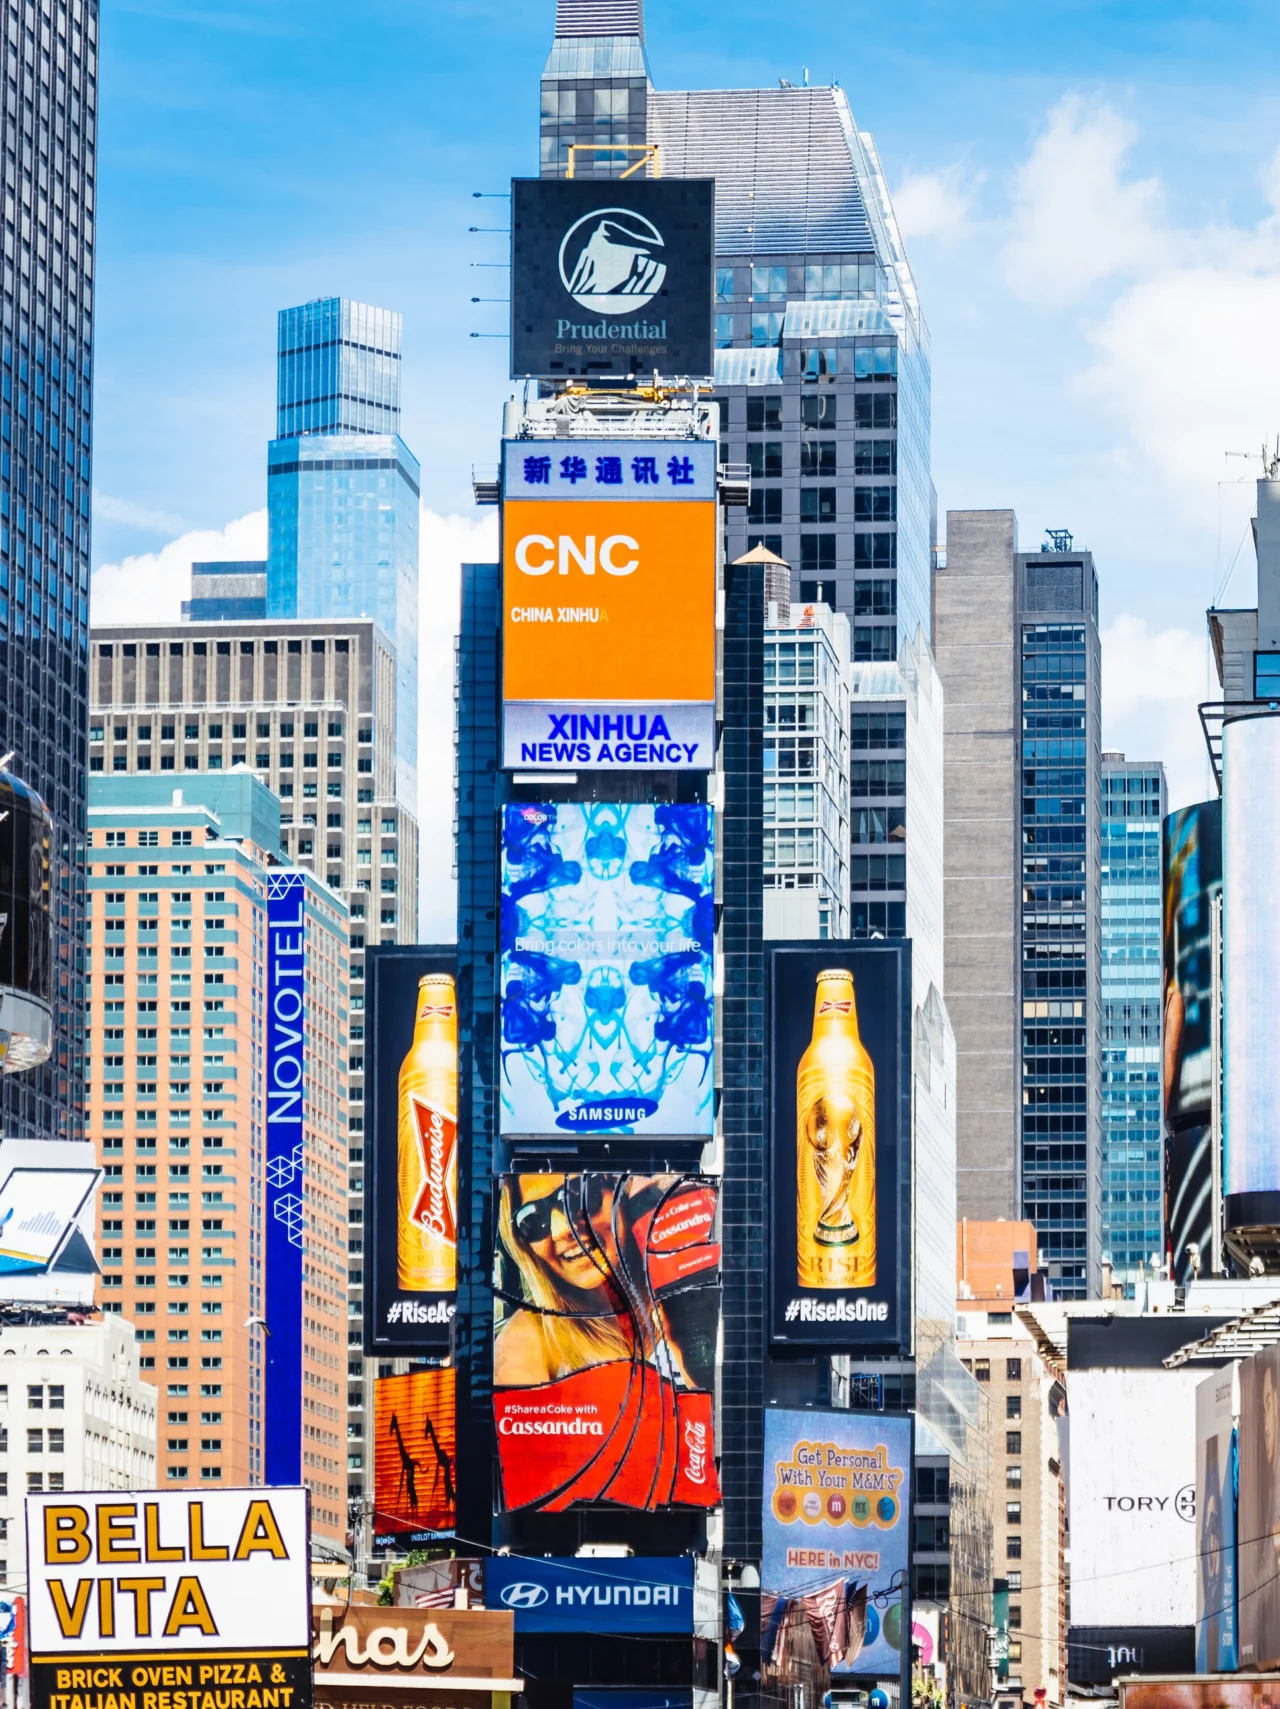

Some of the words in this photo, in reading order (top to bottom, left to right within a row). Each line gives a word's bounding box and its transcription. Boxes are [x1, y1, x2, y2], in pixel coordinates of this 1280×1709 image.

[555, 319, 668, 340] Prudential
[554, 343, 583, 356] Bring
[585, 343, 608, 354] Your
[611, 343, 668, 356] Challenges
[523, 455, 696, 486] 新华通讯社
[514, 533, 640, 577] CNC
[510, 606, 554, 623] CHINA
[547, 714, 673, 741] XINHUA
[521, 742, 592, 763] NEWS
[596, 742, 700, 763] AGENCY
[514, 937, 556, 956] Bring
[559, 937, 605, 952] colors
[607, 937, 639, 952] into
[640, 938, 676, 956] your
[678, 937, 702, 953] life
[267, 901, 304, 1124] NOVOTEL
[568, 1107, 647, 1122] SAMSUNG
[420, 1106, 446, 1250] Budweise
[650, 1212, 712, 1244] Cassandra
[807, 1255, 867, 1274] RISE
[784, 1297, 889, 1322] #RiseAsOne
[574, 1404, 598, 1415] with
[498, 1416, 604, 1437] Cassandra
[797, 1447, 823, 1466] Get
[826, 1449, 883, 1470] Personal
[779, 1467, 813, 1486] With
[817, 1470, 848, 1488] Your
[1103, 1496, 1169, 1512] TORY
[43, 1499, 290, 1567] BELLA
[788, 1550, 826, 1567] HERE
[829, 1552, 841, 1568] in
[843, 1552, 879, 1570] NYC!
[555, 1585, 680, 1606] HYUNDAI
[46, 1574, 221, 1641] VITA
[314, 1607, 455, 1668] has
[56, 1667, 124, 1690] BRICK
[131, 1665, 193, 1687] OVEN
[200, 1663, 263, 1685] PIZZA
[270, 1662, 287, 1684] &
[50, 1691, 138, 1709] ITALIAN
[146, 1687, 294, 1709] RESTAURANT
